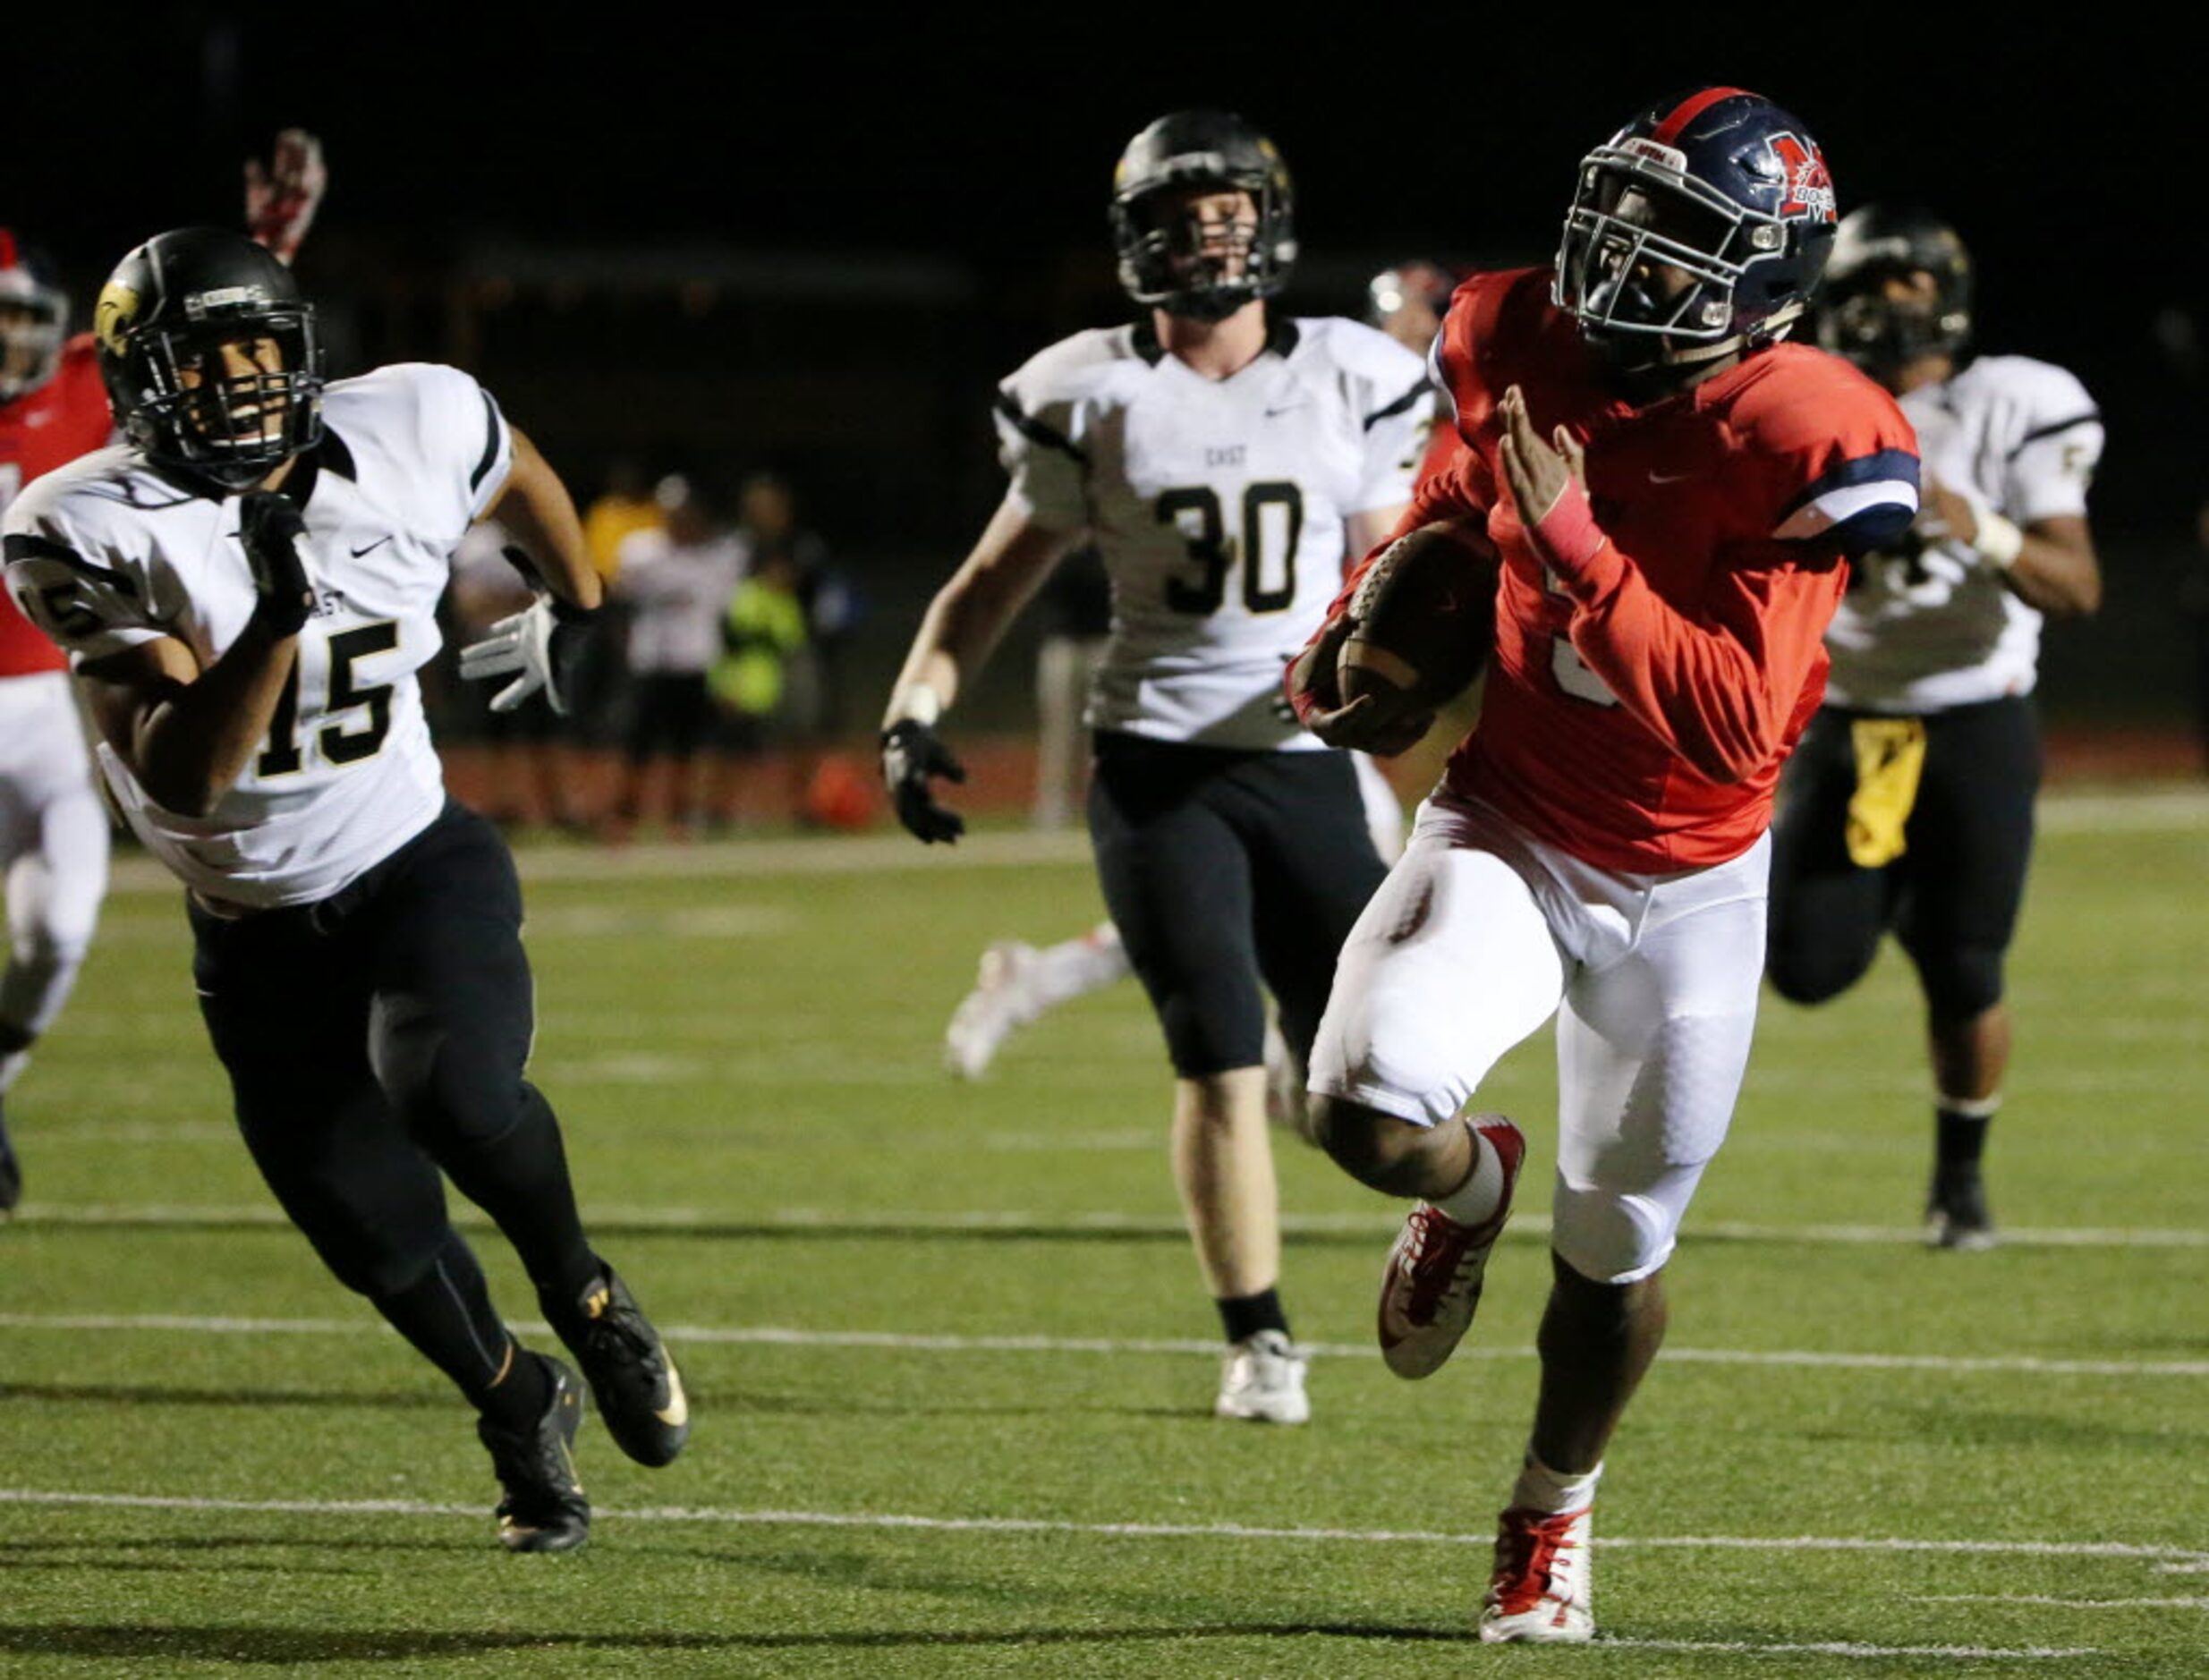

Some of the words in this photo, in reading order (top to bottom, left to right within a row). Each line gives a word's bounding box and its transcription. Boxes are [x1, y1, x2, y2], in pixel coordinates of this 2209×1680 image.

[1204, 445, 1247, 468] EAST
[1154, 479, 1304, 616] 30
[252, 618, 401, 781] 15
